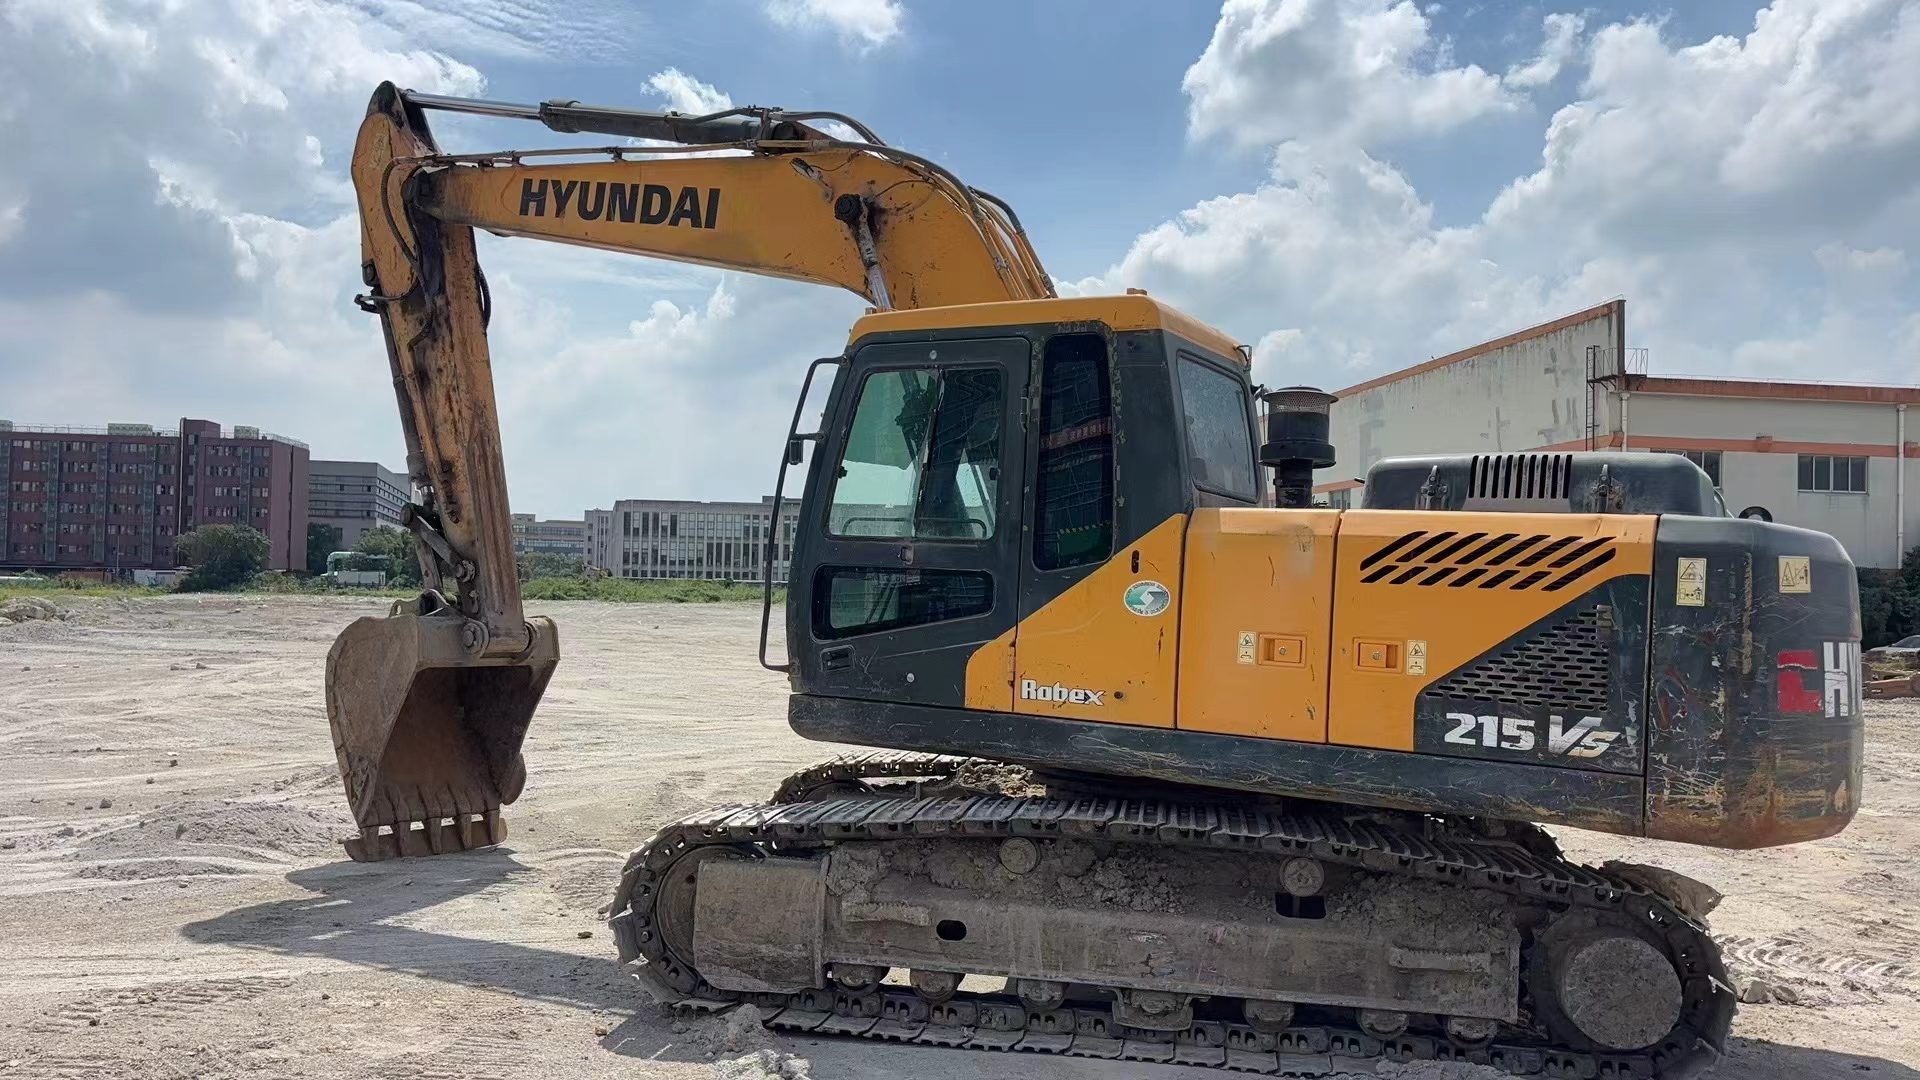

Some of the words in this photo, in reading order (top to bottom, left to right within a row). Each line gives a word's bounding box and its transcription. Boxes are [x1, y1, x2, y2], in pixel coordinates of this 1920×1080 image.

[519, 178, 720, 229] HYUNDAI
[1021, 679, 1106, 706] Robex
[1444, 713, 1535, 751] 215
